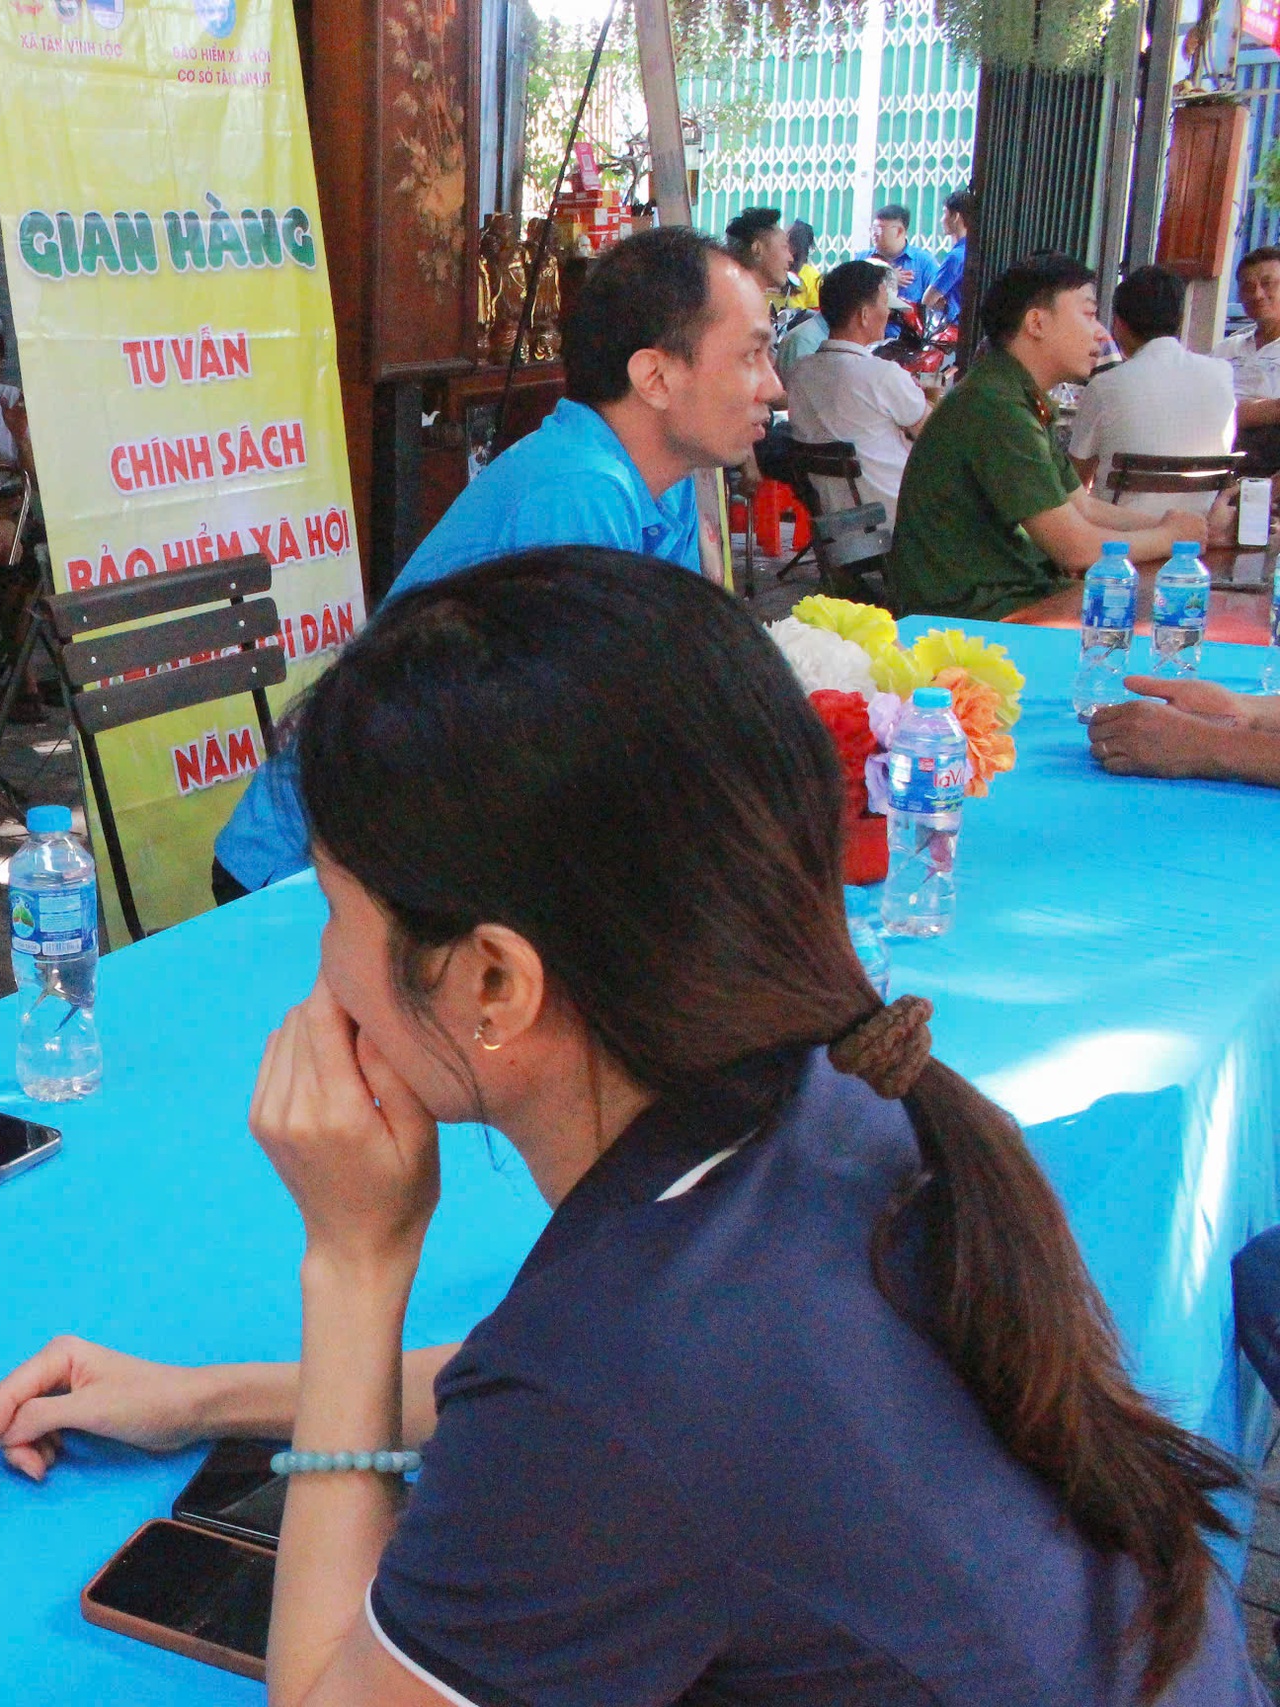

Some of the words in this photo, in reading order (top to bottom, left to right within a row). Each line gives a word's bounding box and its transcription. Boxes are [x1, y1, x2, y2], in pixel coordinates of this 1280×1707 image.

[41, 34, 64, 53] TÂN
[100, 39, 124, 60] LỘC
[19, 209, 158, 279] GIAN
[163, 191, 315, 271] HÀNG
[171, 326, 249, 380] VẤN
[111, 436, 214, 491] CHÍNH
[217, 423, 306, 476] SÁCH
[67, 544, 158, 592] BẢO
[249, 517, 303, 566] XÃ
[305, 507, 351, 557] HỘI
[300, 602, 355, 654] DÂN
[174, 728, 259, 791] NĂM
